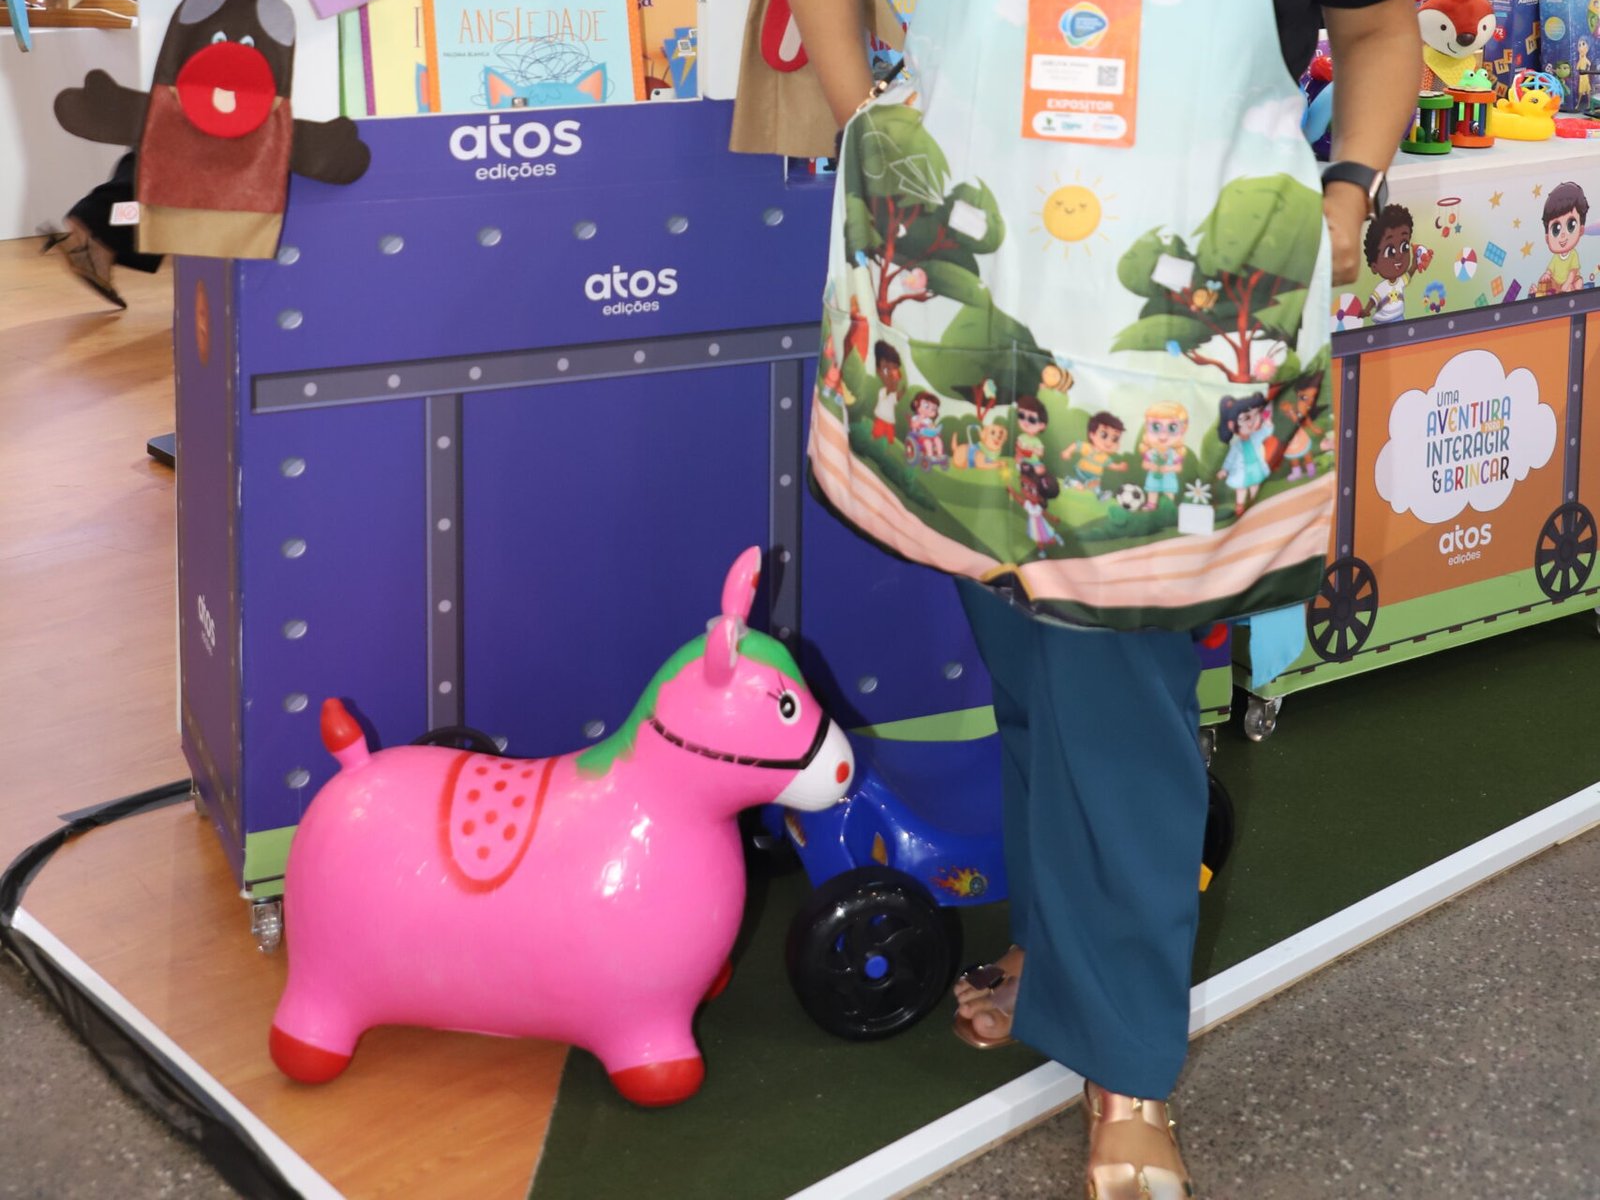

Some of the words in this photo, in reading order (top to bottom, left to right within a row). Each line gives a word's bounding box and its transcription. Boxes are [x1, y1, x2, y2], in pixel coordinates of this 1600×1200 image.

[458, 7, 608, 44] ANSIEDADE
[1046, 98, 1115, 113] EXPOSITOR
[449, 115, 582, 161] atos
[475, 162, 557, 181] edições
[584, 265, 678, 301] atos
[602, 300, 660, 316] edições
[1437, 389, 1459, 407] UMA
[1427, 396, 1511, 437] AVENTURA
[1426, 426, 1510, 468] INTERAGIR
[1439, 523, 1492, 554] atos
[1448, 550, 1481, 566] edições
